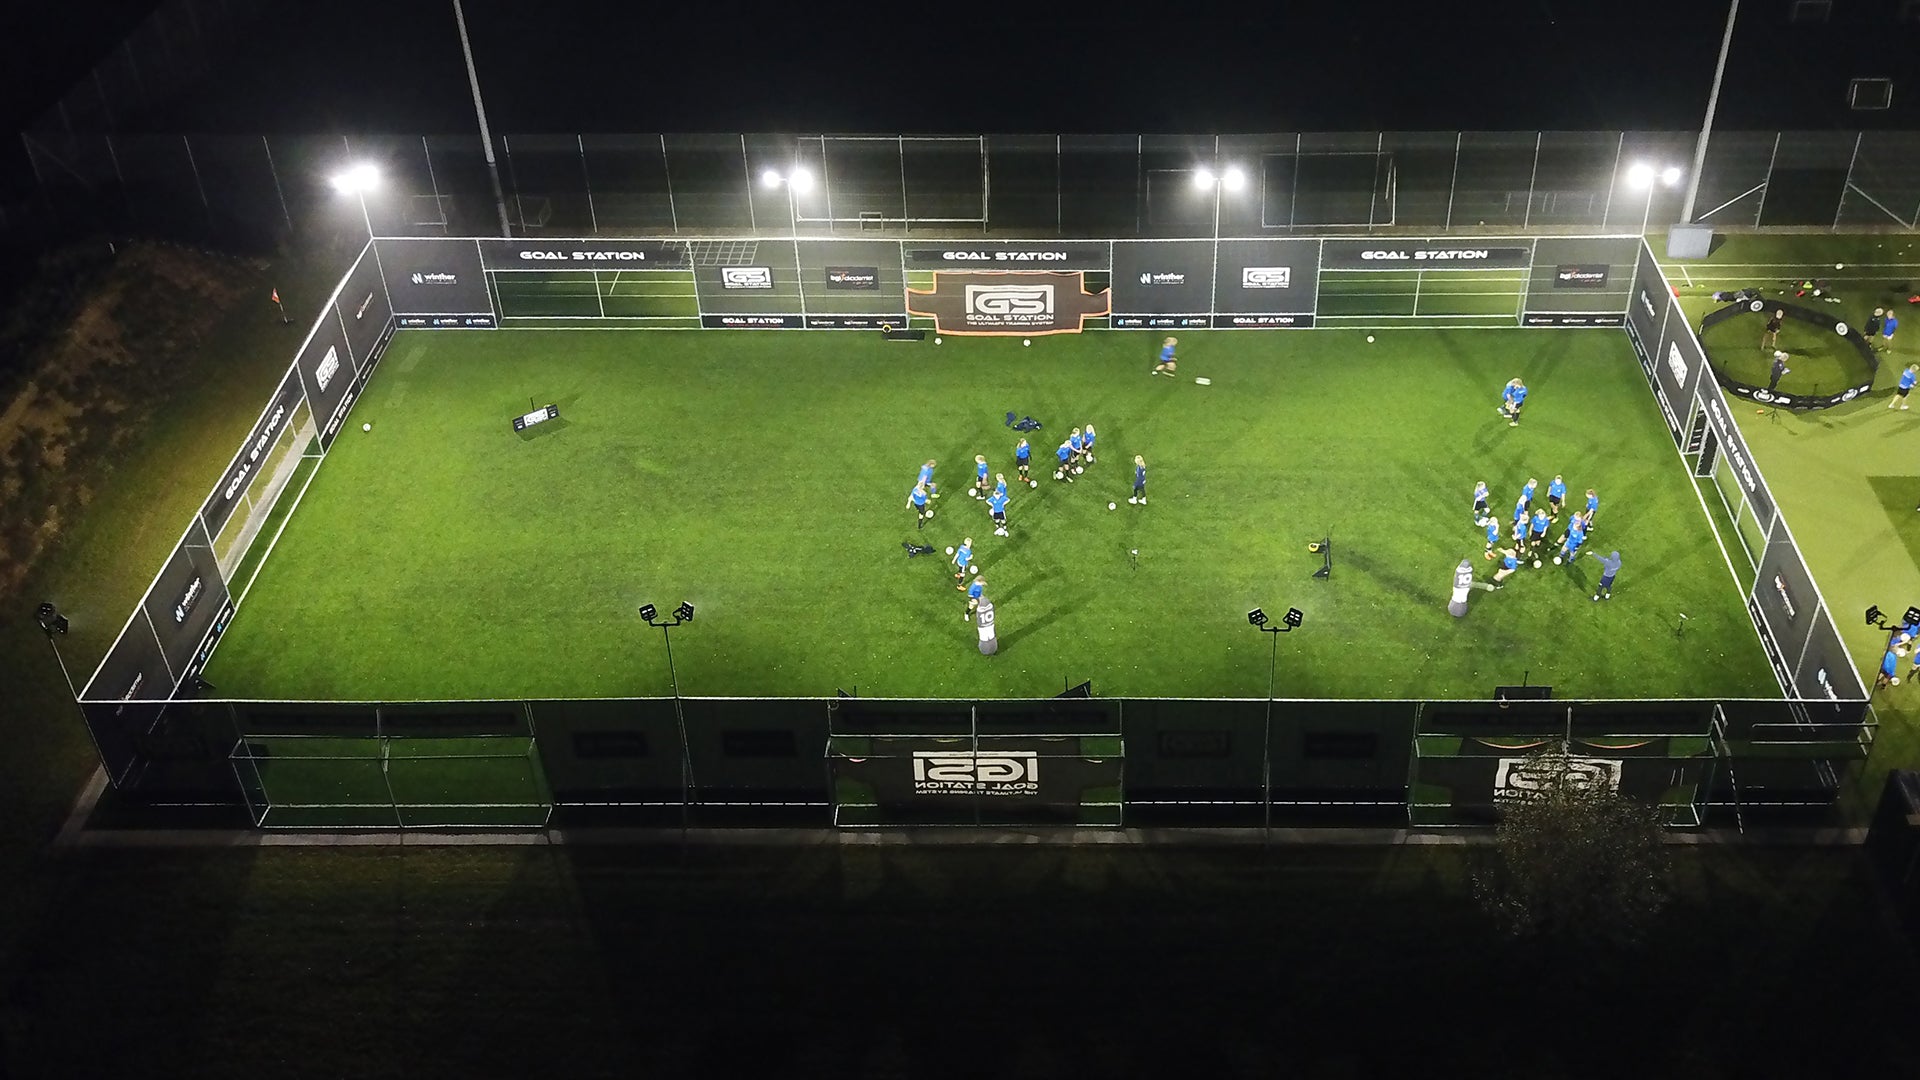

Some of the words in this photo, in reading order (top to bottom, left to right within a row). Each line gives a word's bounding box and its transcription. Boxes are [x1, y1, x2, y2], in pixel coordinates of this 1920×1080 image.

[519, 251, 568, 260] GOAL
[572, 251, 645, 260] STATION
[942, 251, 991, 261] GOAL
[995, 251, 1067, 261] STATION
[1361, 251, 1410, 260] GOAL
[1414, 250, 1488, 260] STATION
[975, 291, 1045, 314] GS
[1711, 398, 1728, 437] GOAL
[1727, 434, 1756, 492] STATION
[225, 463, 251, 500] GOAL
[250, 404, 284, 462] STATION
[1457, 573, 1472, 585] 10
[979, 610, 995, 624] 10
